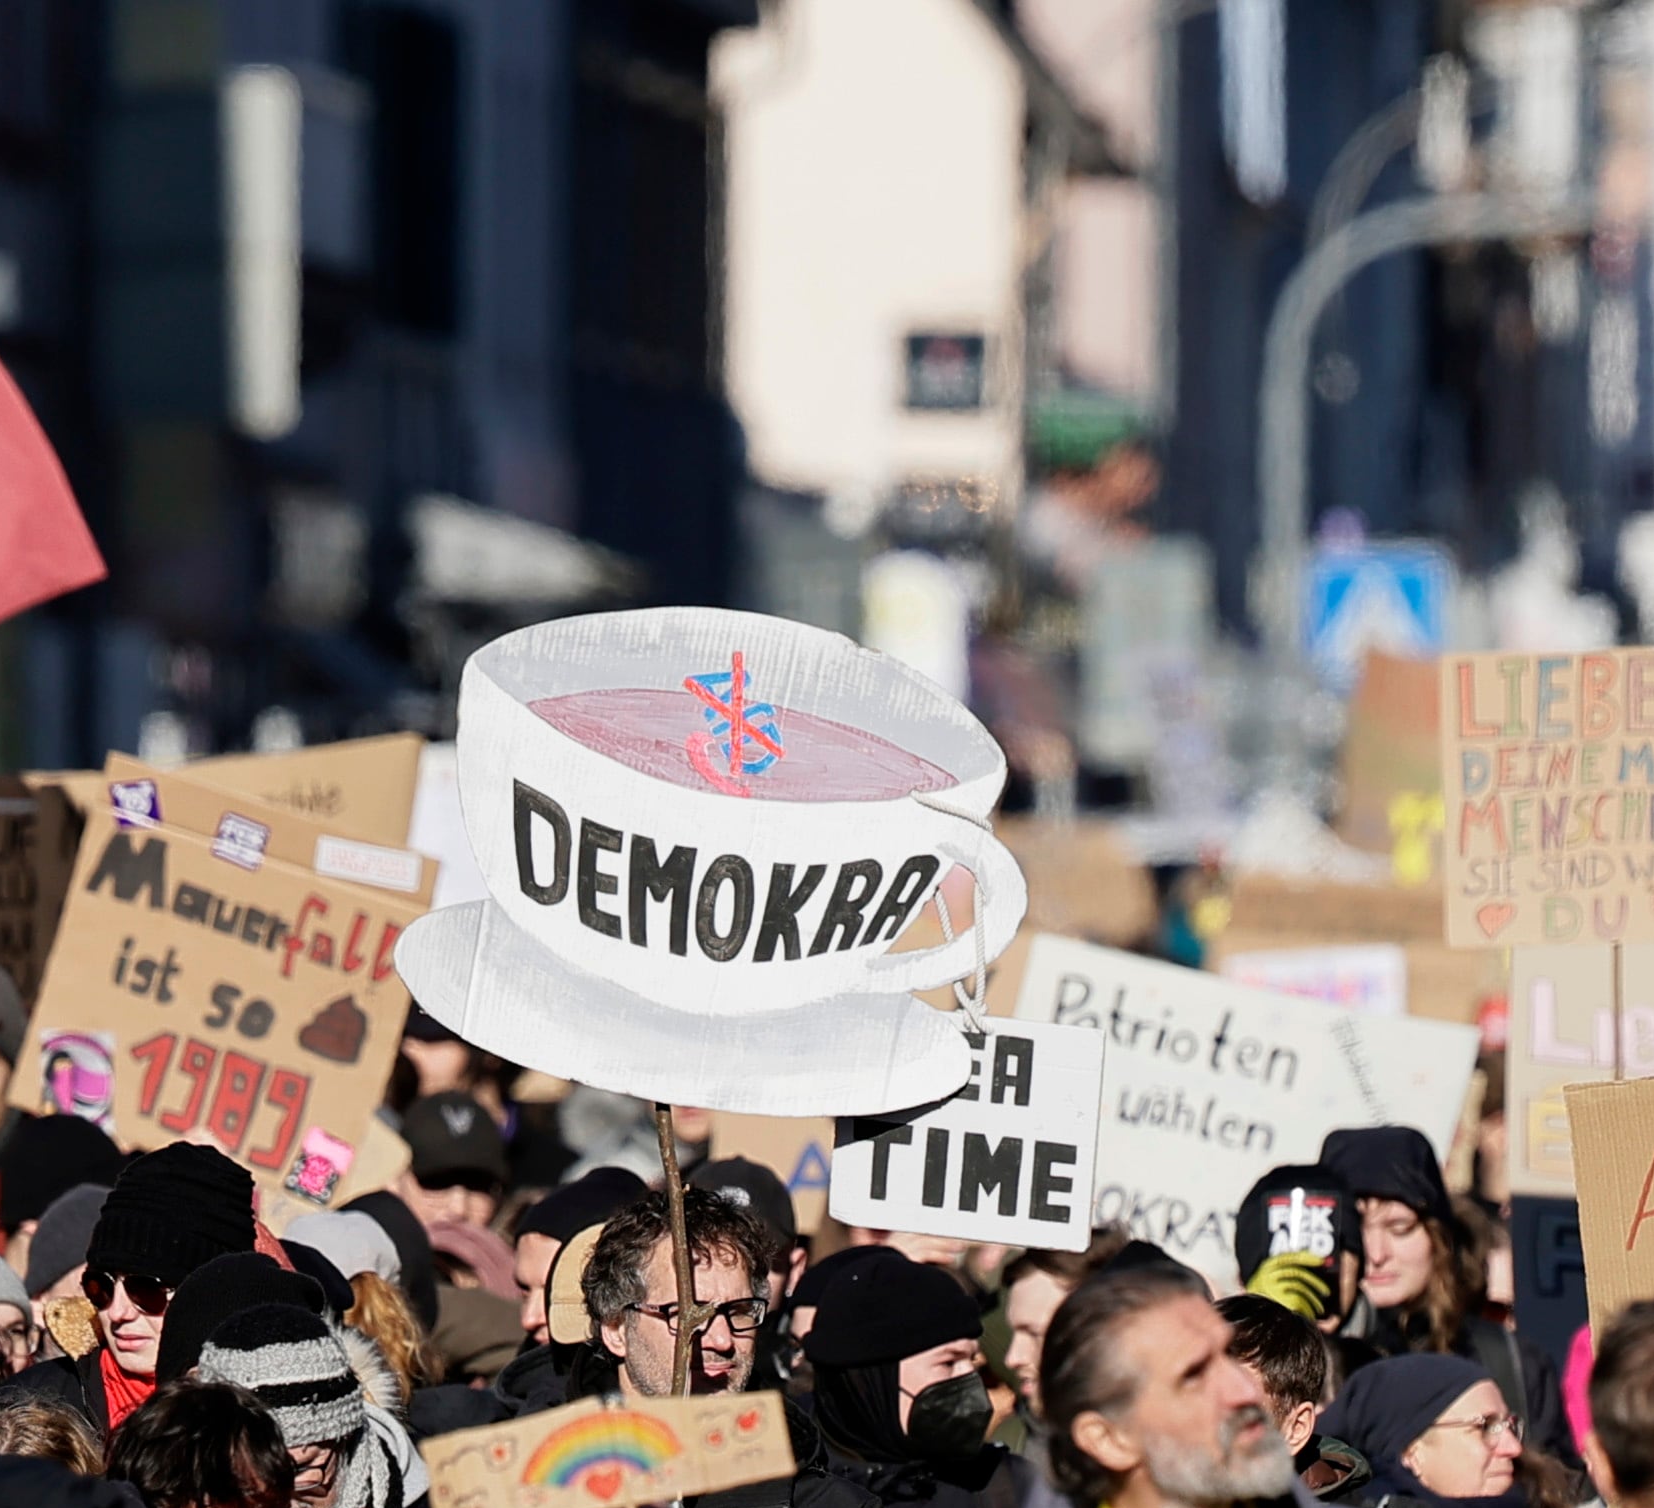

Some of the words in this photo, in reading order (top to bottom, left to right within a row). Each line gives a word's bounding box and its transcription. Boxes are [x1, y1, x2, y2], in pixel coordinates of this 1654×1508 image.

[1461, 745, 1602, 795] DEINE
[86, 832, 402, 984] Mauerfall
[512, 777, 941, 963] DEMOKRA
[1462, 855, 1518, 897] SIE
[1530, 852, 1616, 892] SIND
[1542, 895, 1630, 941] DU
[113, 936, 184, 1004] ist
[204, 982, 276, 1039] so
[130, 1031, 312, 1174] 1989
[953, 1030, 1035, 1107] EA
[1118, 1084, 1277, 1153] wählen
[856, 1123, 1079, 1224] TIME
[1095, 1183, 1237, 1254] OKRA
